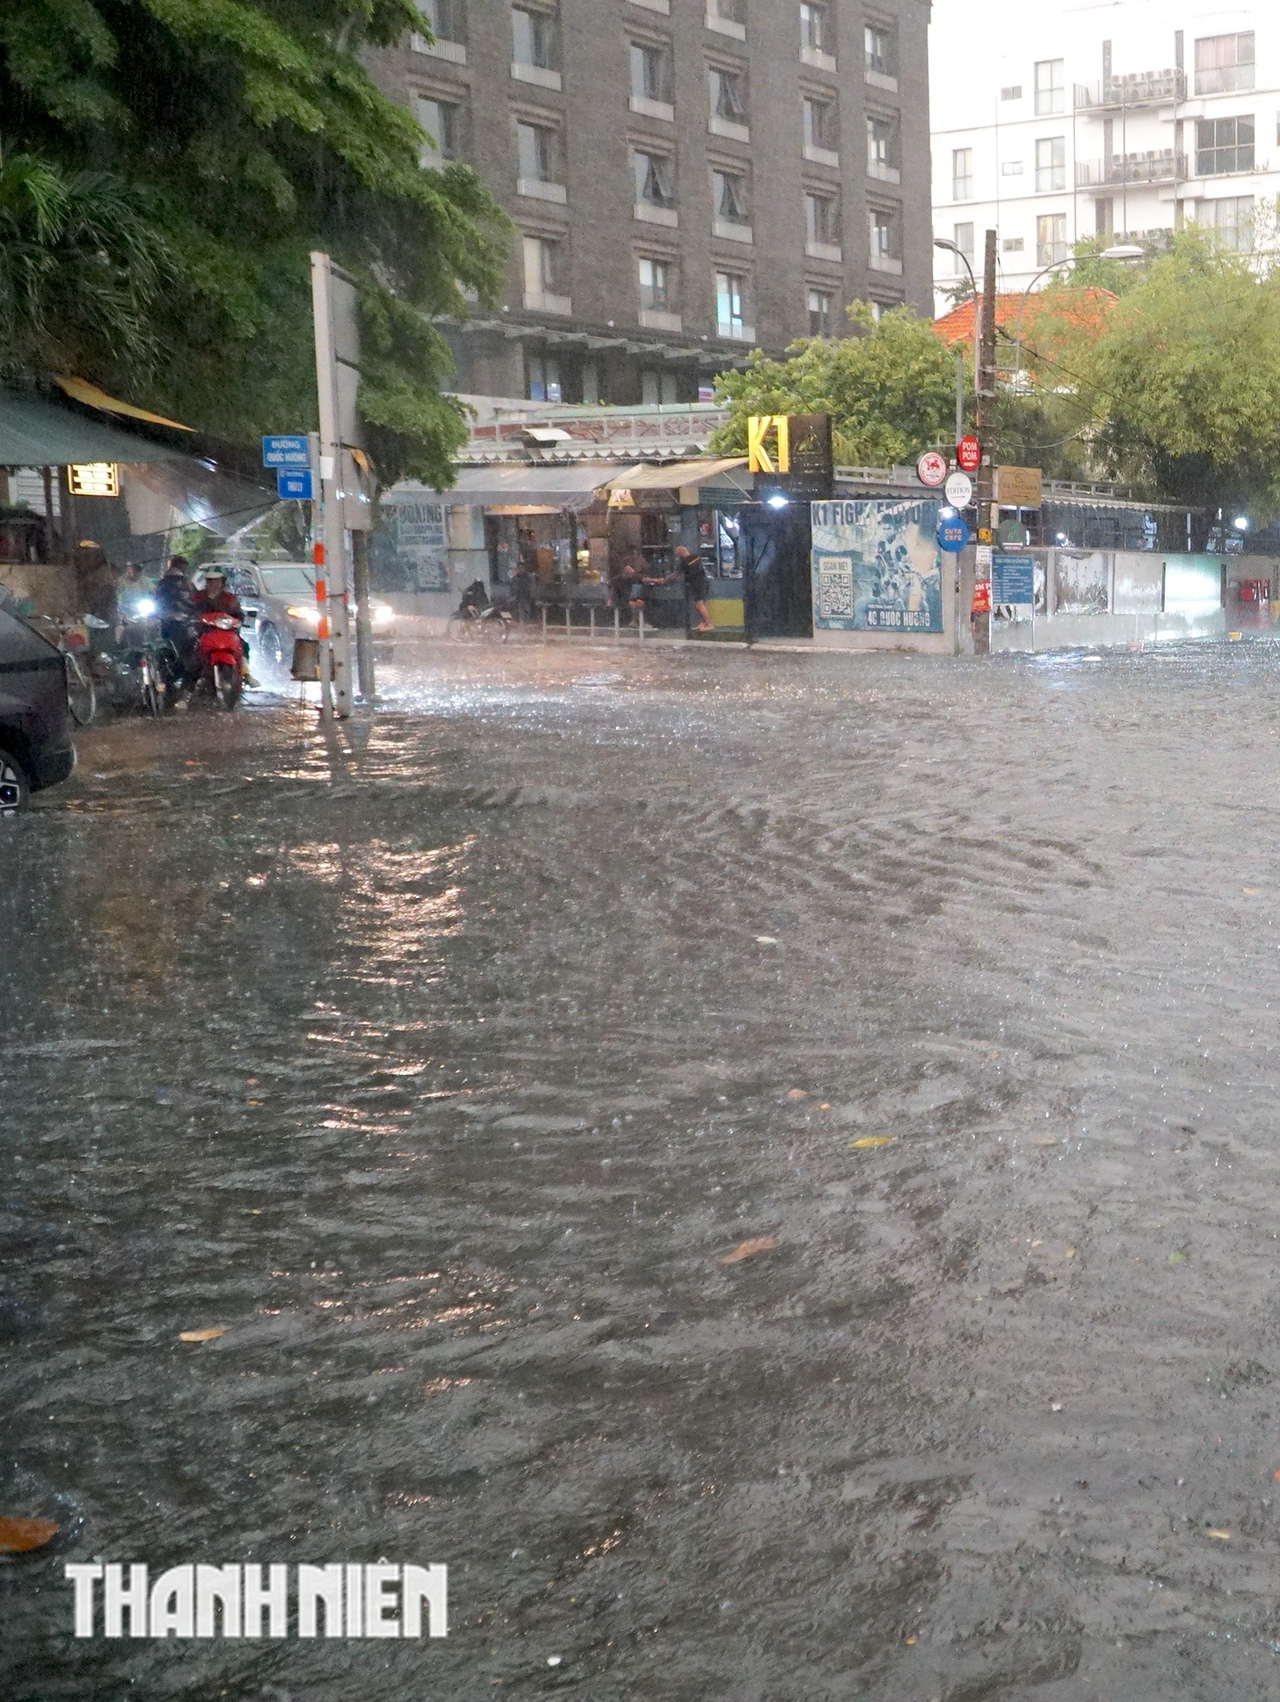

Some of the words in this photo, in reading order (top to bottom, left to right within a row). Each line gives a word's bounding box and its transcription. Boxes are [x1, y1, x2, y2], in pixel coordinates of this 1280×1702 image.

[748, 415, 790, 473] K1
[963, 442, 977, 450] POM
[963, 452, 977, 460] POM
[812, 503, 827, 526] K1
[823, 561, 837, 571] SCAN
[868, 611, 877, 625] 4C
